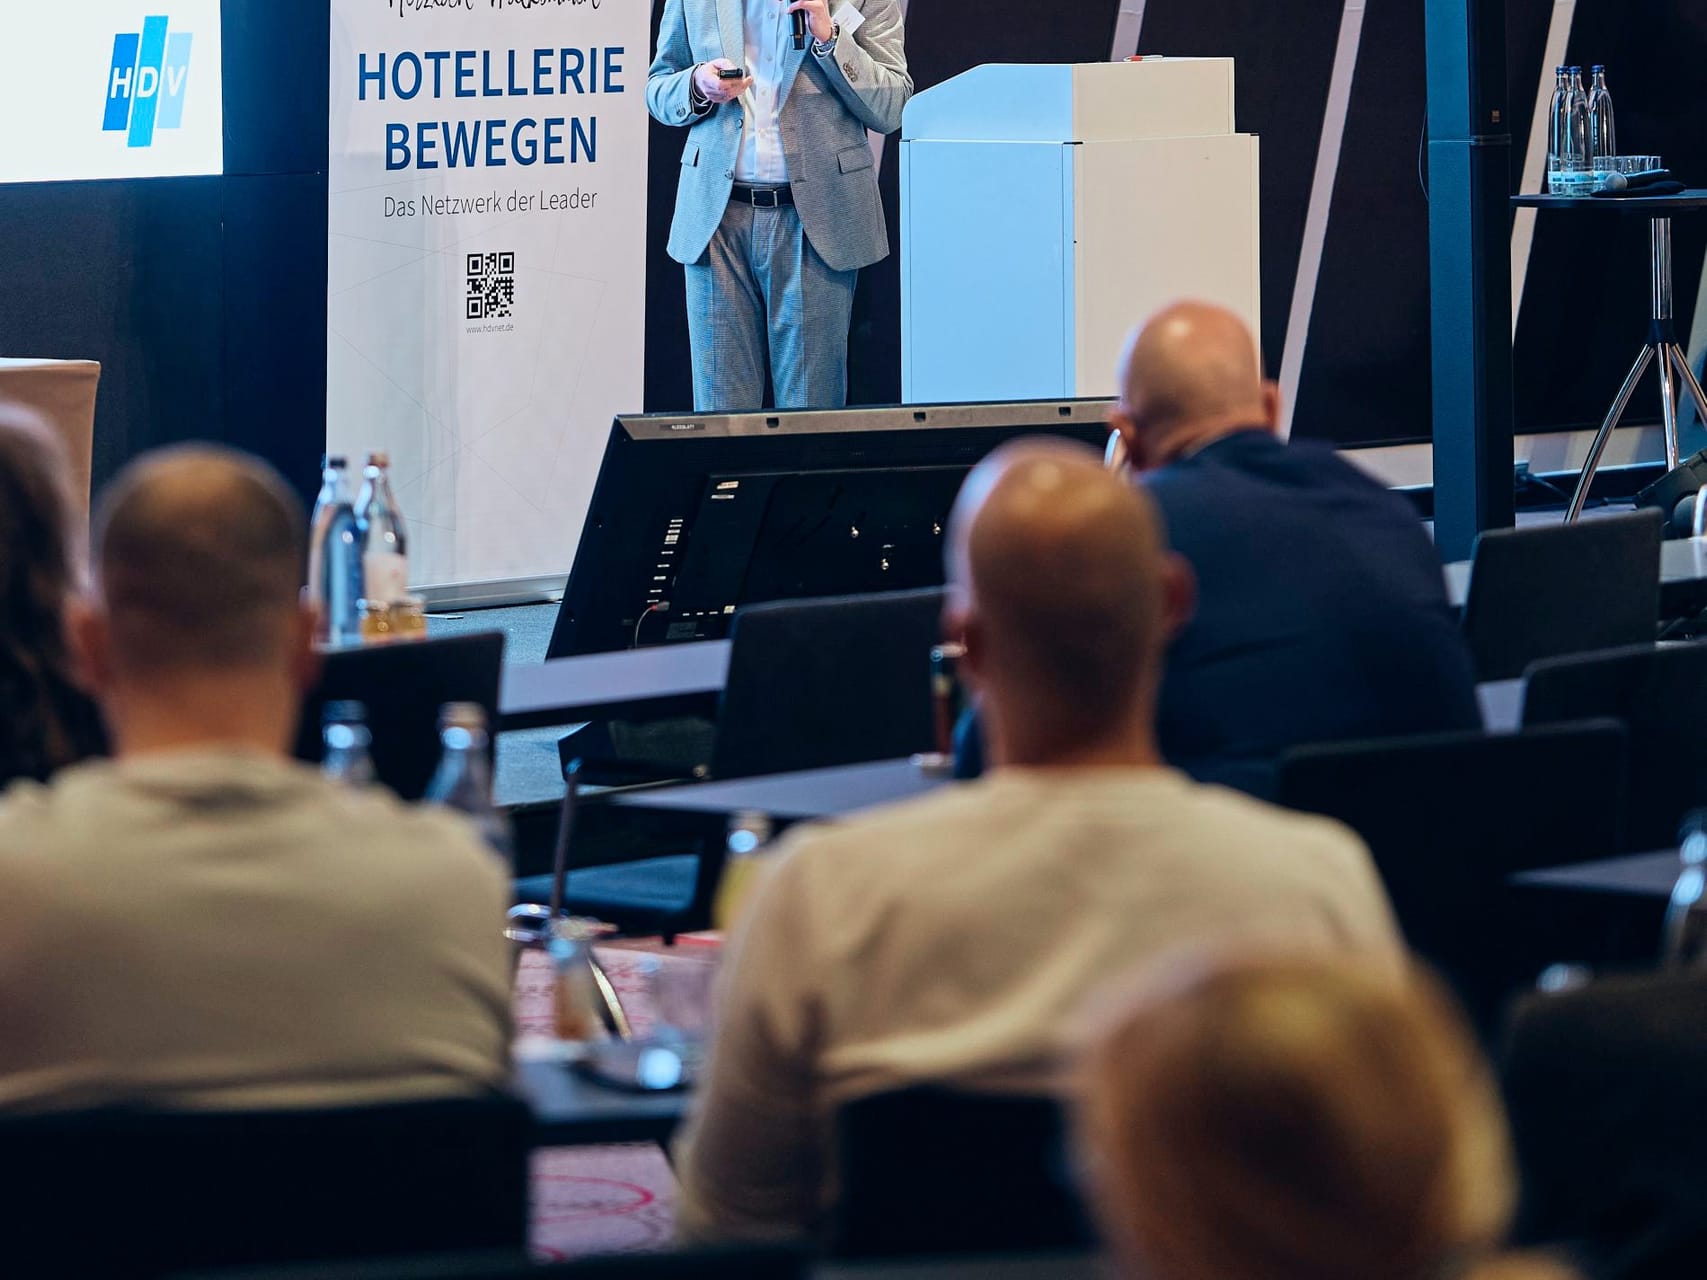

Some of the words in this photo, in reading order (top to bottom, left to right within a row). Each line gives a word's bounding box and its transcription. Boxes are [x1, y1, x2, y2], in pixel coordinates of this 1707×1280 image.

[110, 66, 186, 99] HDV
[358, 47, 625, 100] HOTELLERIE
[385, 116, 597, 170] BEWEGEN
[384, 196, 415, 218] Das
[421, 191, 502, 216] Netzwerk
[506, 189, 535, 212] der
[540, 186, 598, 210] Leader
